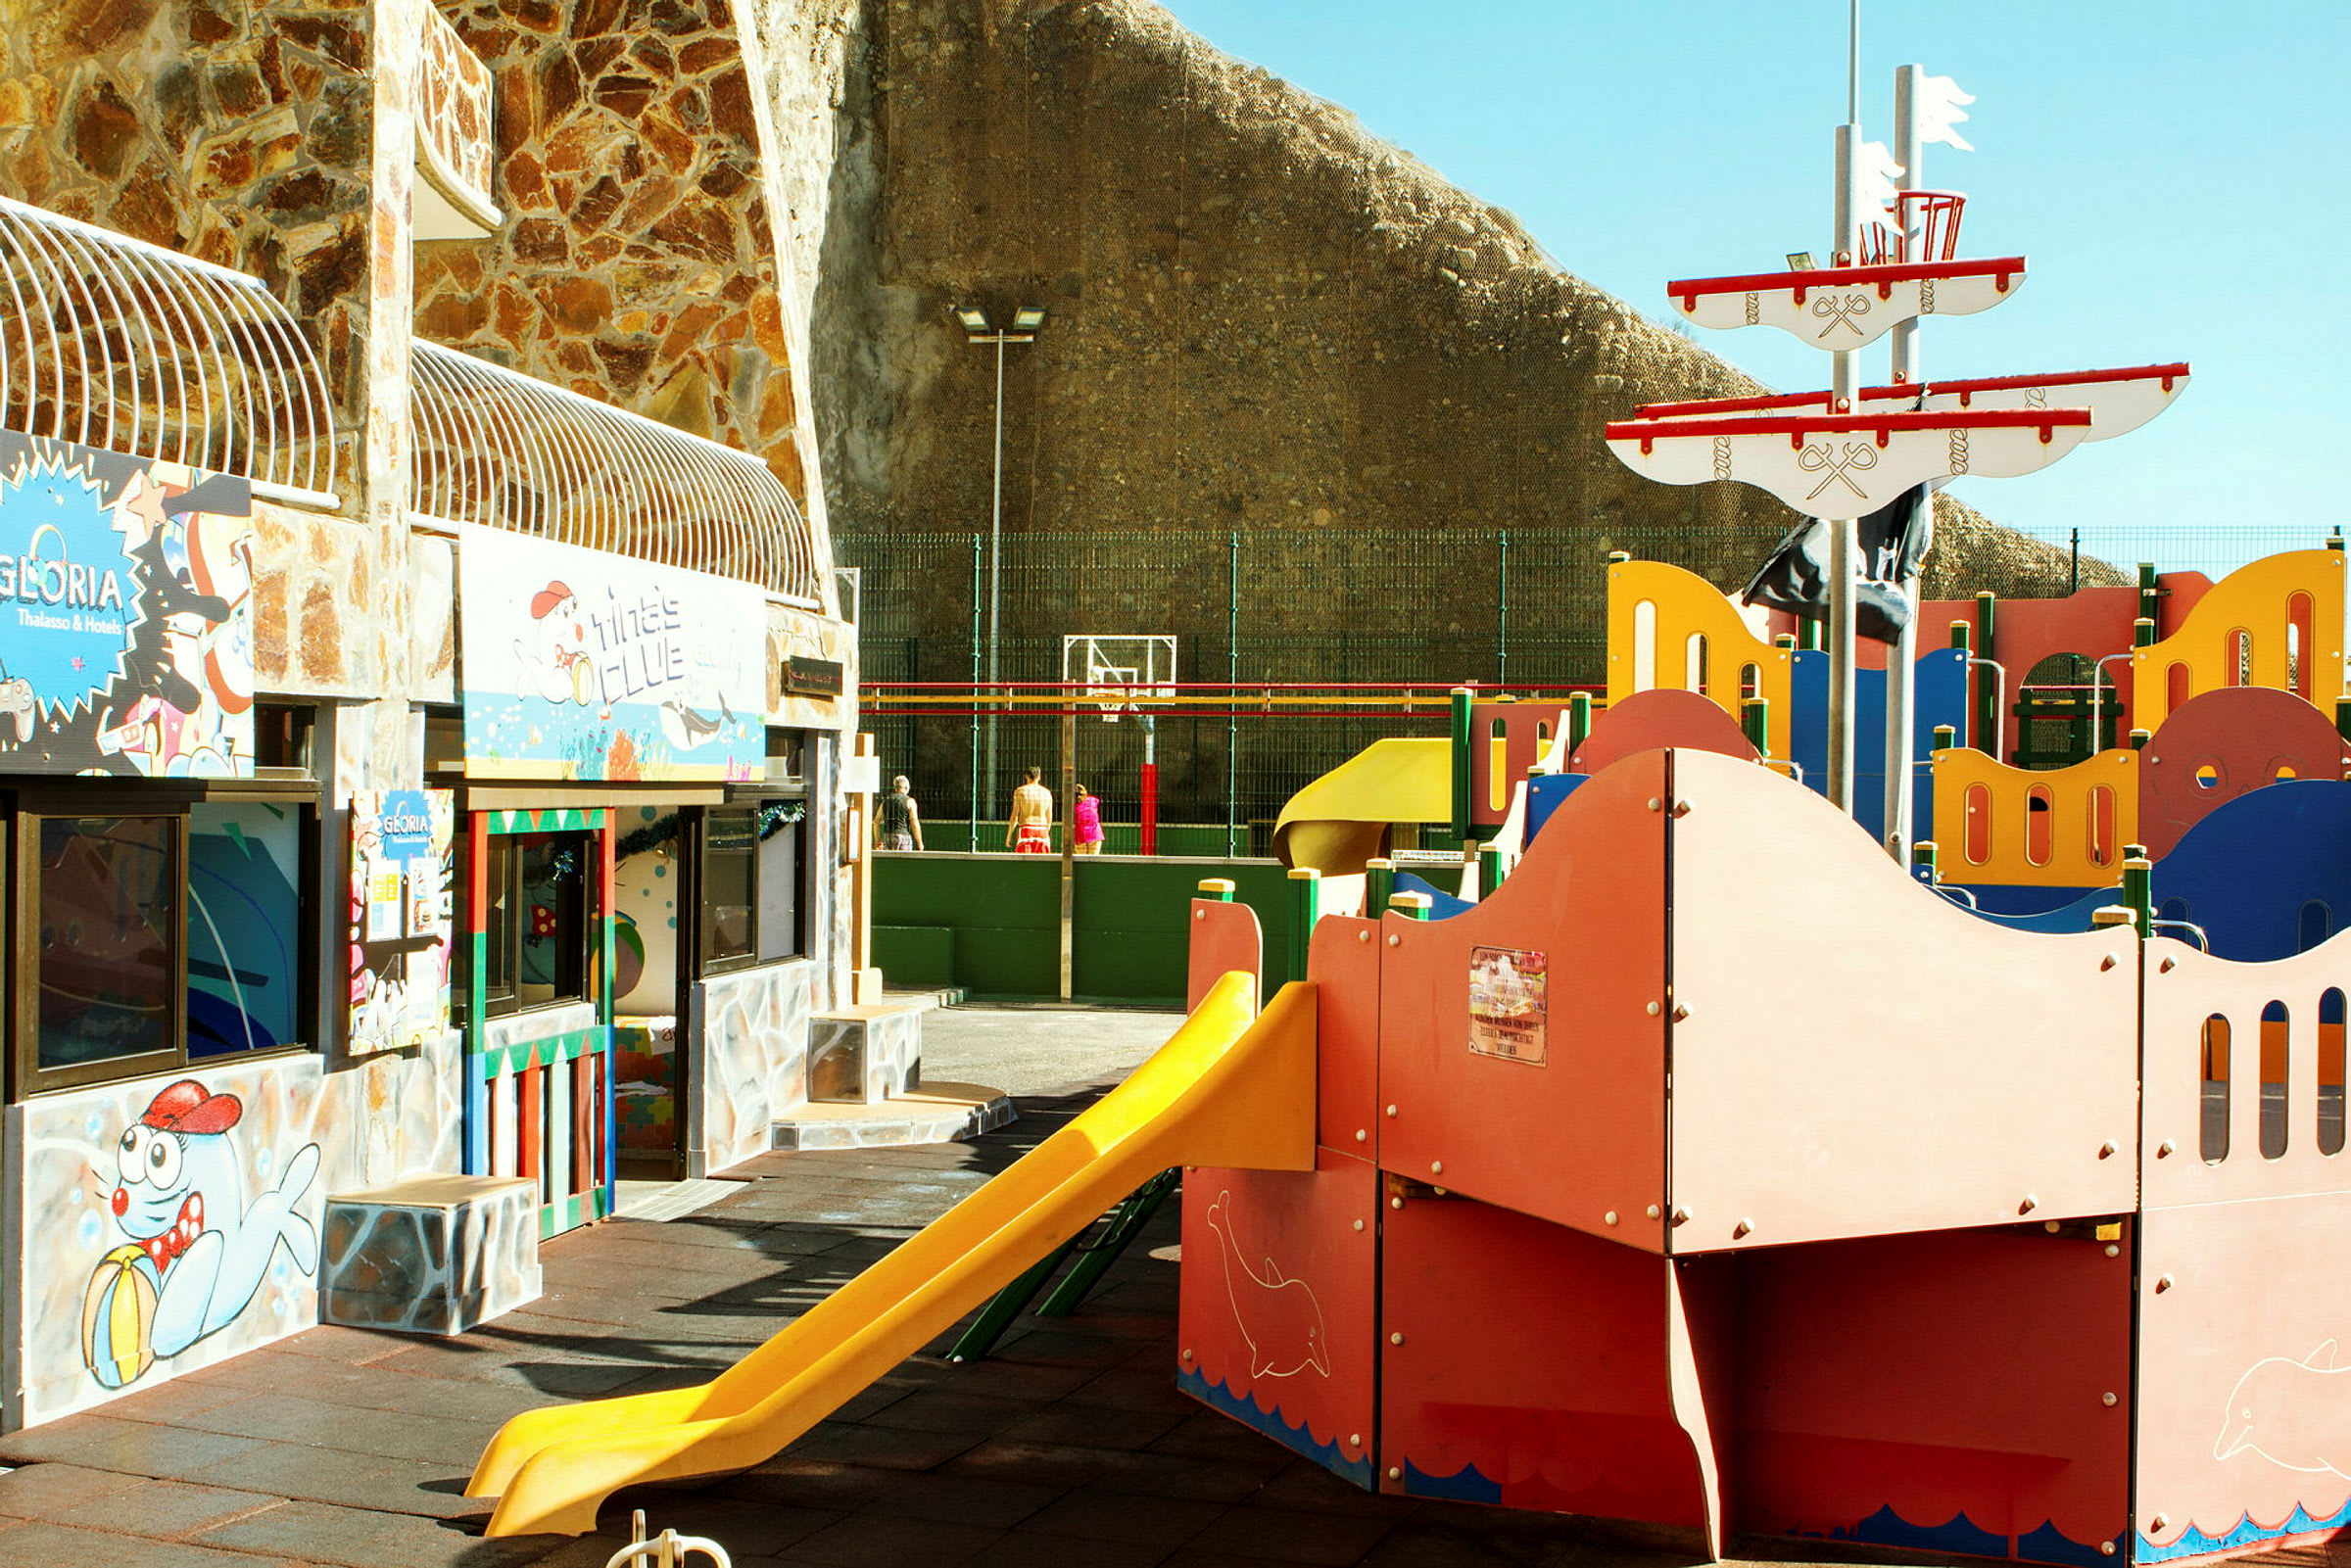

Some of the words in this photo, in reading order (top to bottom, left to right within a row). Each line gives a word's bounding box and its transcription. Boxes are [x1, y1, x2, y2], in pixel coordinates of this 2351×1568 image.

[0, 555, 123, 611] GLORIA
[17, 608, 71, 630] Thalasso
[72, 614, 83, 632] &
[85, 616, 122, 635] Hotels
[384, 815, 428, 834] GLORIA
